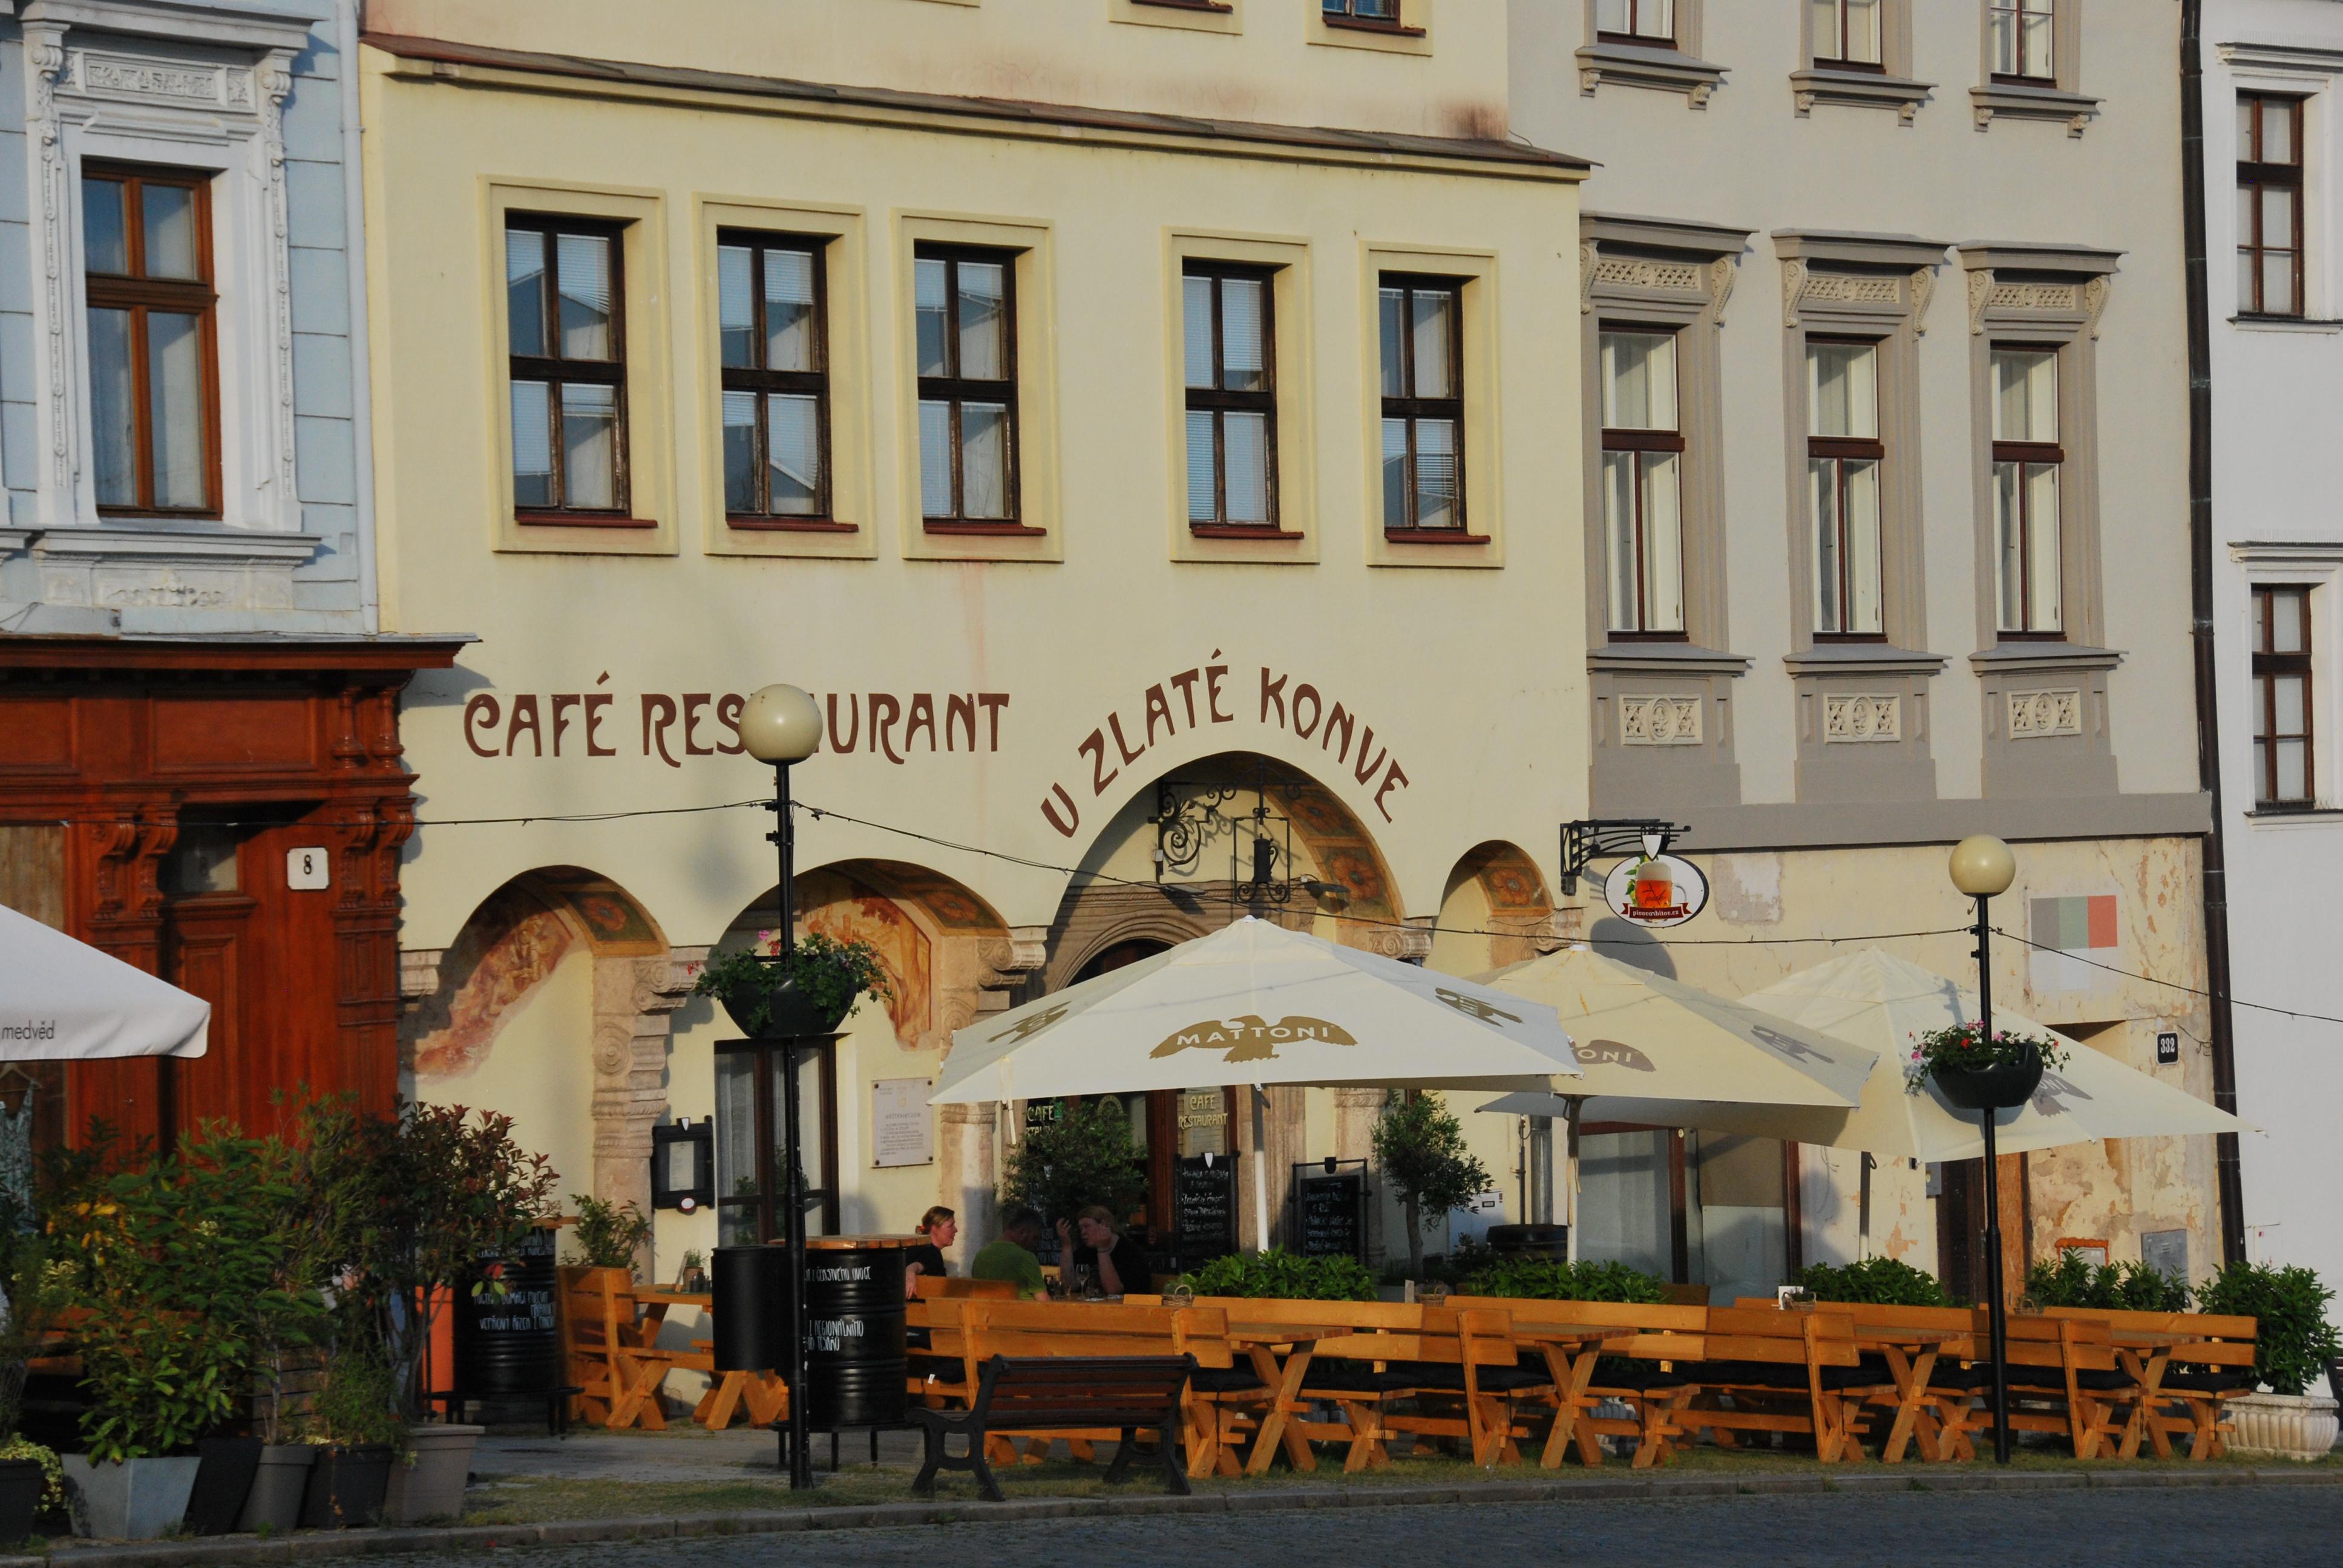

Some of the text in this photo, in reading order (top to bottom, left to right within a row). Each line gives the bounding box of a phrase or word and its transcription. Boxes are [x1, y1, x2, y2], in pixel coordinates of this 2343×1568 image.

[464, 670, 1010, 768] CAFÉ RESURANT
[1040, 648, 1409, 838] U ZLATÉ KONVE
[304, 854, 312, 875] 8
[2, 1020, 55, 1040] medvěd
[1177, 1027, 1328, 1045] MATTONI
[2160, 1037, 2175, 1053] 332
[1190, 1095, 1216, 1110] CAFE
[1178, 1113, 1228, 1129] RESTAURANT
[852, 1266, 871, 1280] OVOCE
